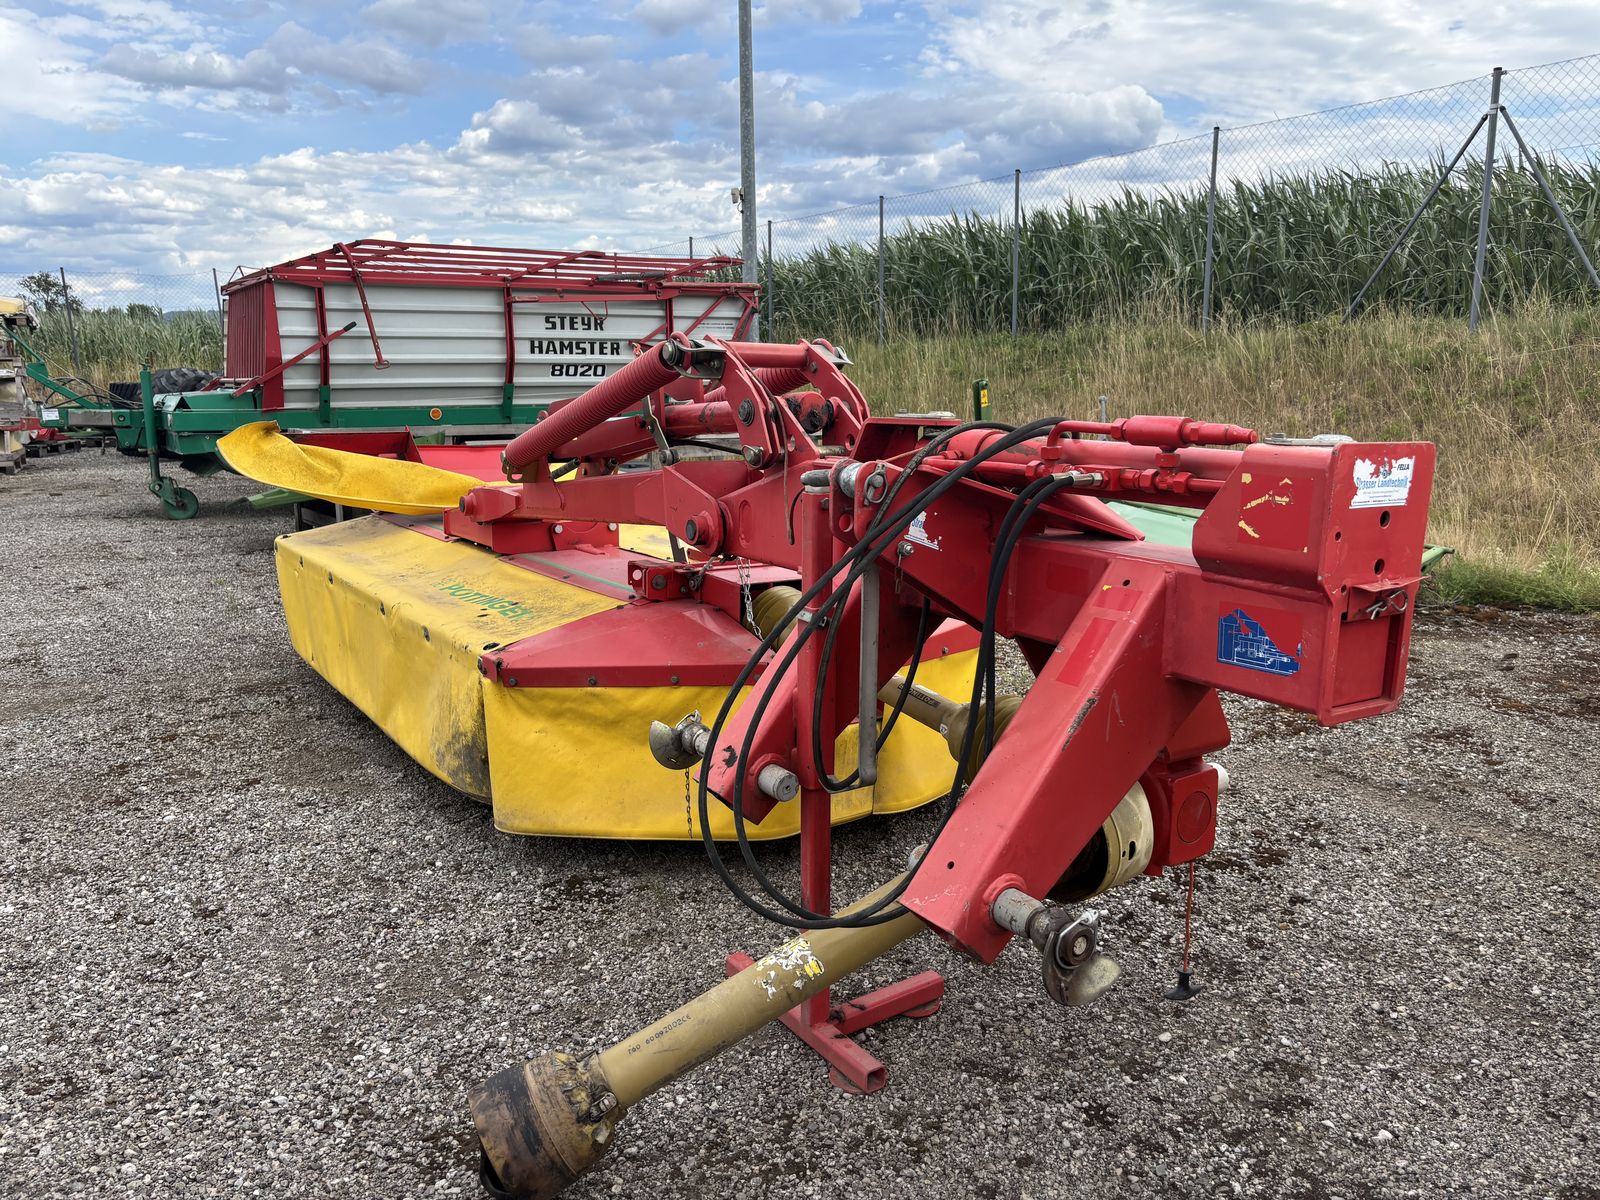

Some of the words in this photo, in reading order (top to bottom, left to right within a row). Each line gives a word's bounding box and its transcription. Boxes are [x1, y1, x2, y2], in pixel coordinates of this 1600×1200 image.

[544, 315, 605, 331] STEYR
[529, 340, 621, 356] HAMSTER
[550, 363, 607, 377] 8020
[1396, 463, 1410, 471] FELLA
[1377, 475, 1409, 488] Landtechnik
